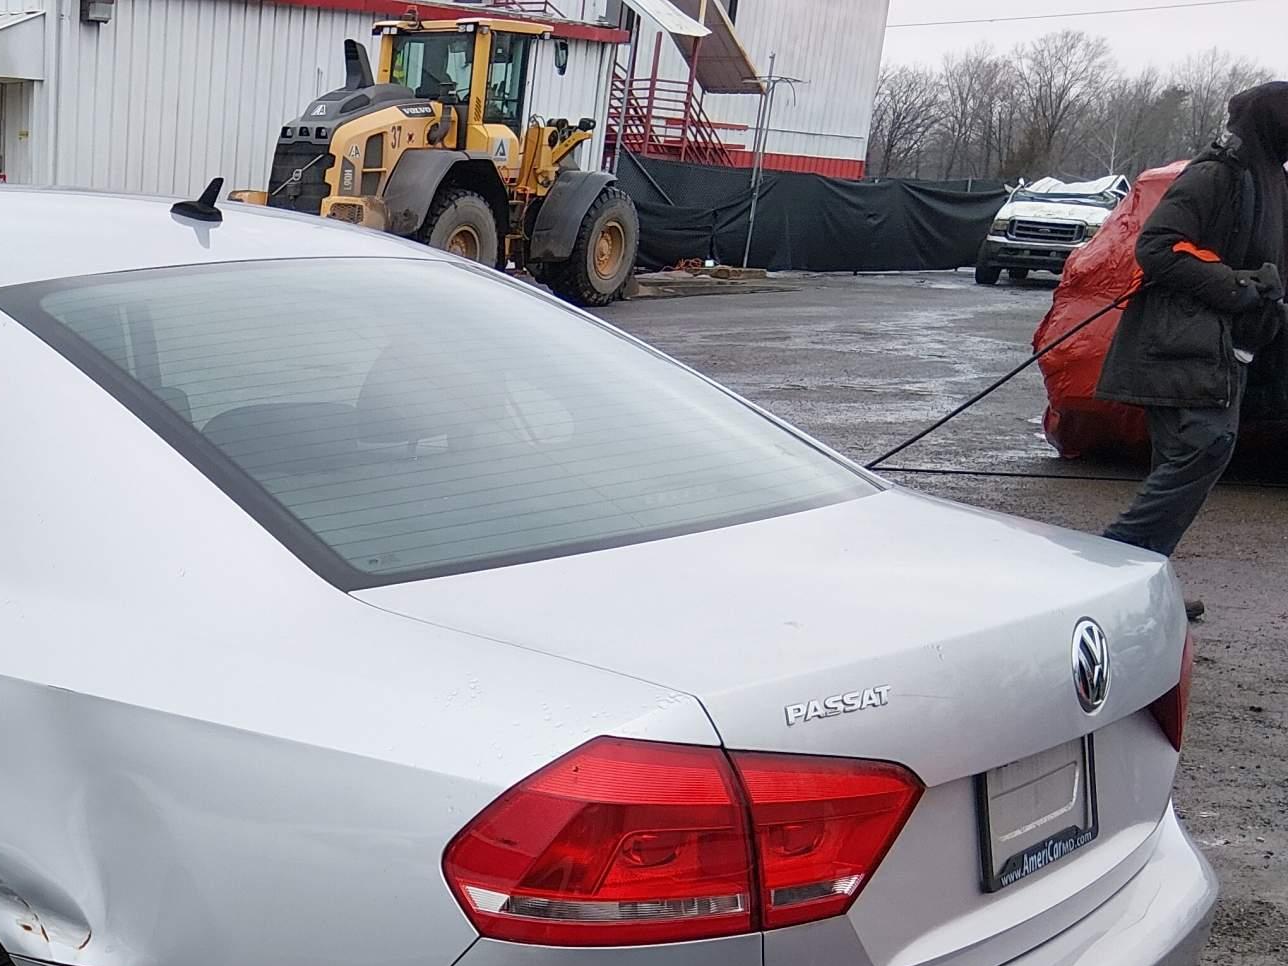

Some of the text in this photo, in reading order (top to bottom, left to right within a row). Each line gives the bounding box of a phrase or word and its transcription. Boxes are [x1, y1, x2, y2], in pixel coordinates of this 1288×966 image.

[402, 106, 432, 115] VOLVO
[391, 126, 402, 149] 37
[344, 169, 353, 191] L90H
[784, 684, 892, 727] PASSAT
